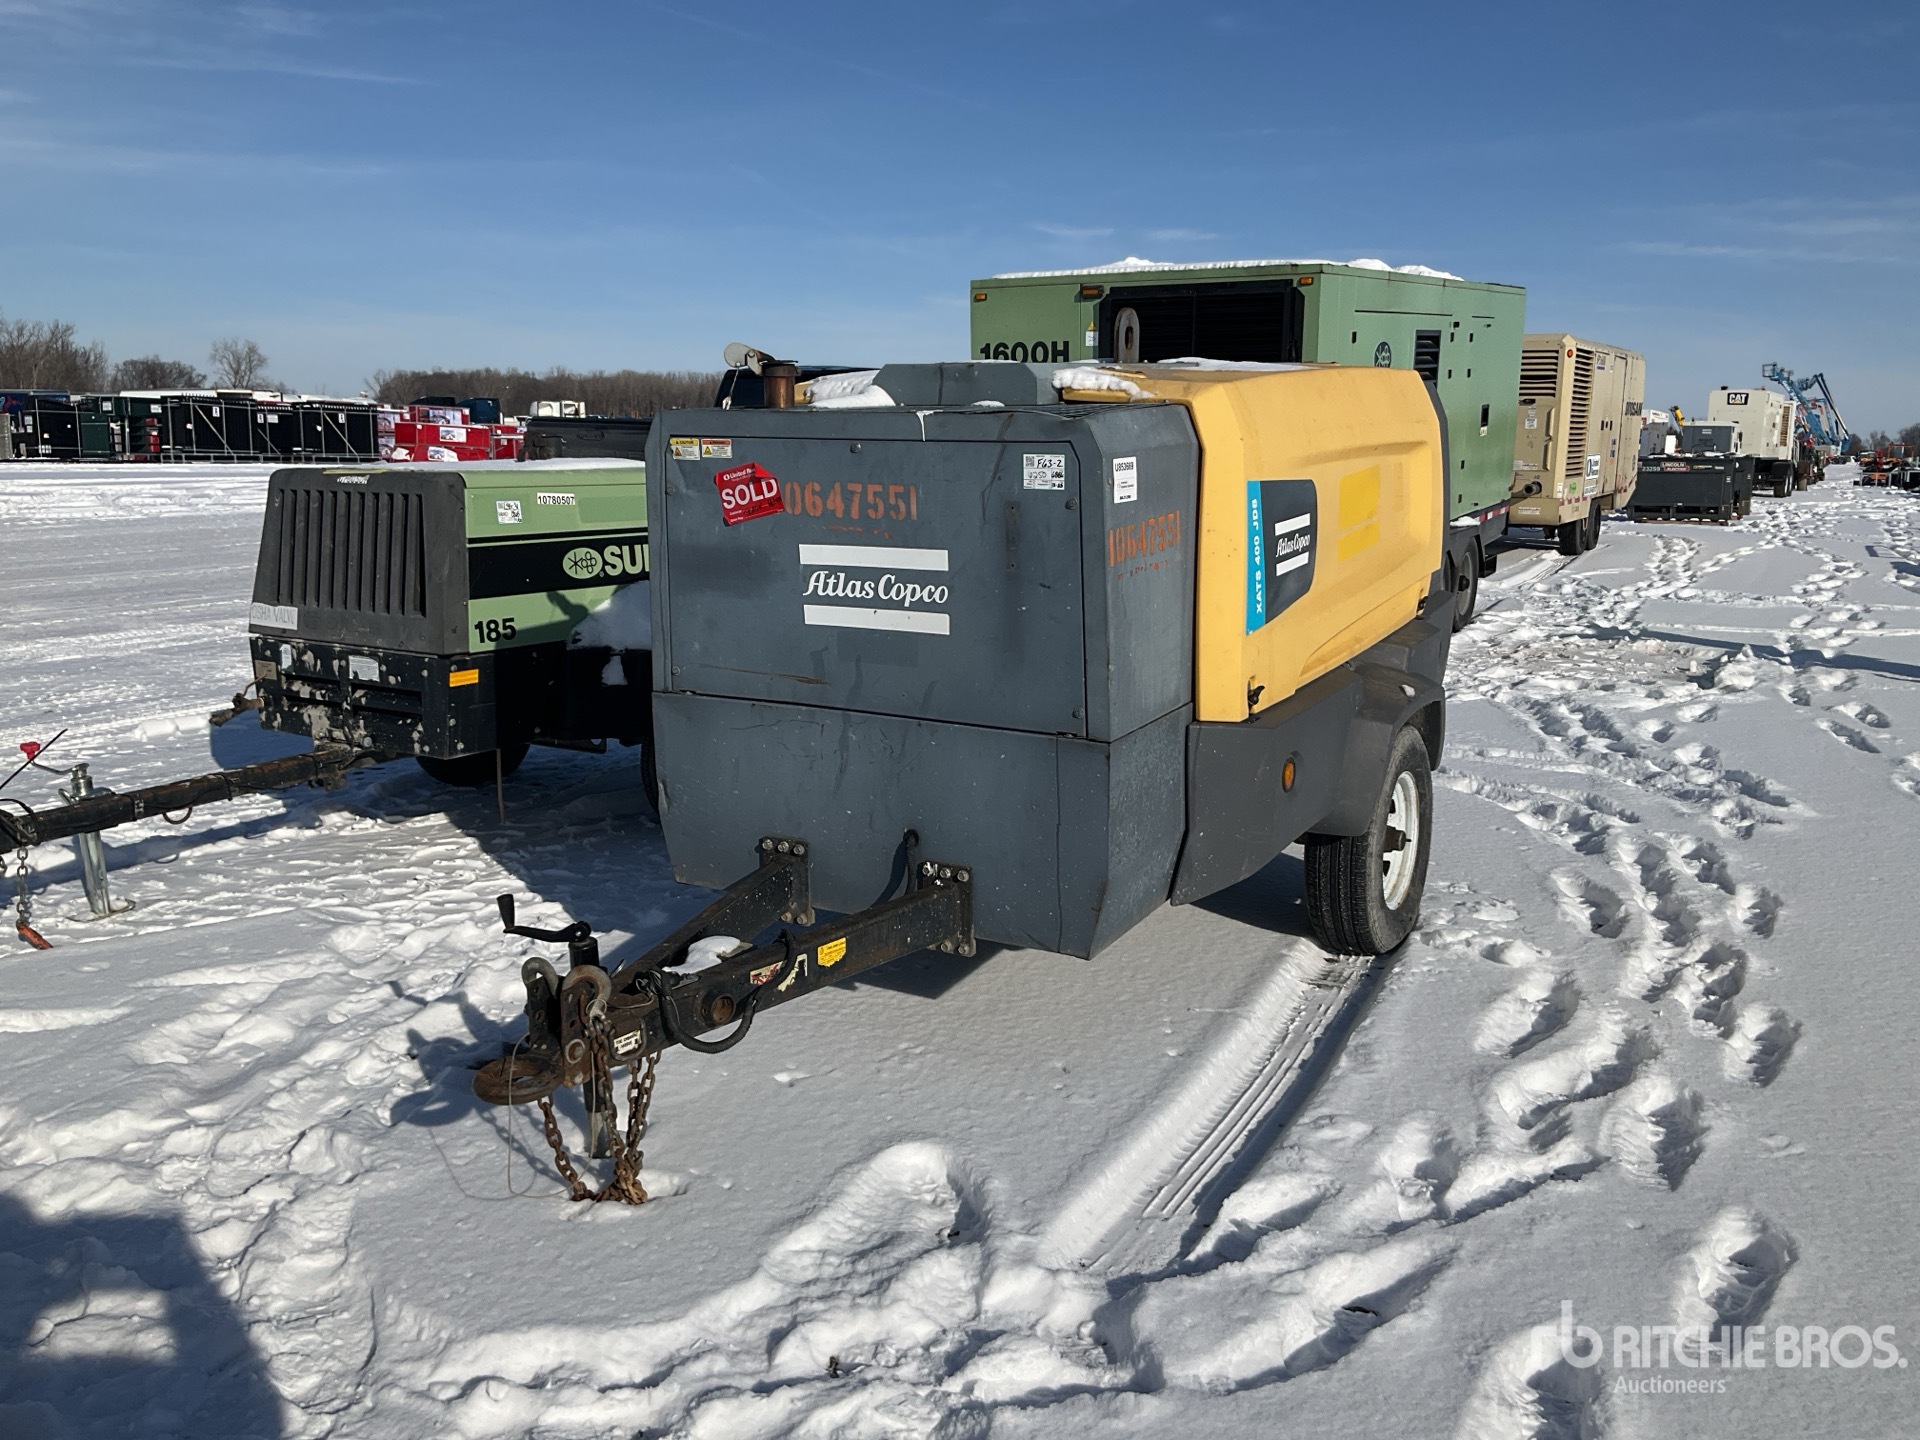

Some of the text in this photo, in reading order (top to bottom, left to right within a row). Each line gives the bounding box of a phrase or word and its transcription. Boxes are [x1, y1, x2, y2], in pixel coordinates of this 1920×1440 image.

[980, 341, 1069, 363] 1600H
[1728, 393, 1748, 404] CAT
[537, 495, 575, 505] 10780507
[721, 478, 778, 509] SOLD
[1108, 510, 1181, 567] 10647551
[1276, 533, 1311, 557] Atlas Copco
[803, 570, 949, 607] Atlas Copco
[474, 617, 516, 644] 185
